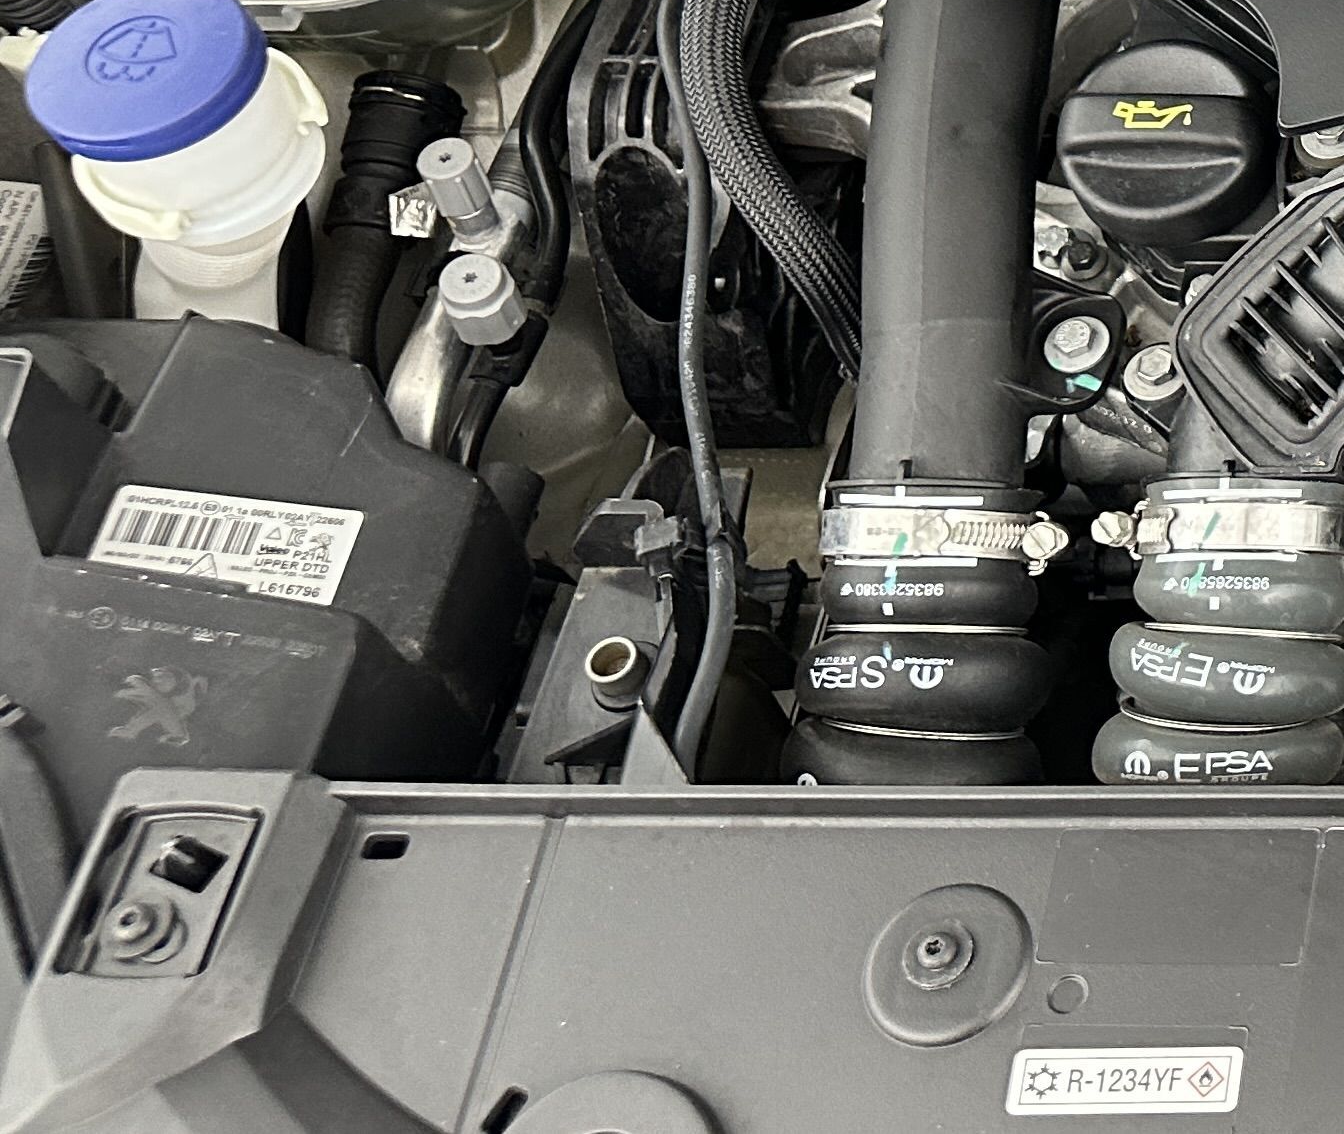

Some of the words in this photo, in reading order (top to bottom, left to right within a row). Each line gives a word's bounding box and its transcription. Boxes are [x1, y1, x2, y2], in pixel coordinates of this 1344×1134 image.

[254, 558, 299, 571] UPPER
[301, 563, 329, 574] DTD
[1130, 647, 1182, 682] PSA
[809, 667, 858, 688] PSA
[1205, 750, 1273, 774] PSA
[1066, 1067, 1183, 1093] R-1234YF
